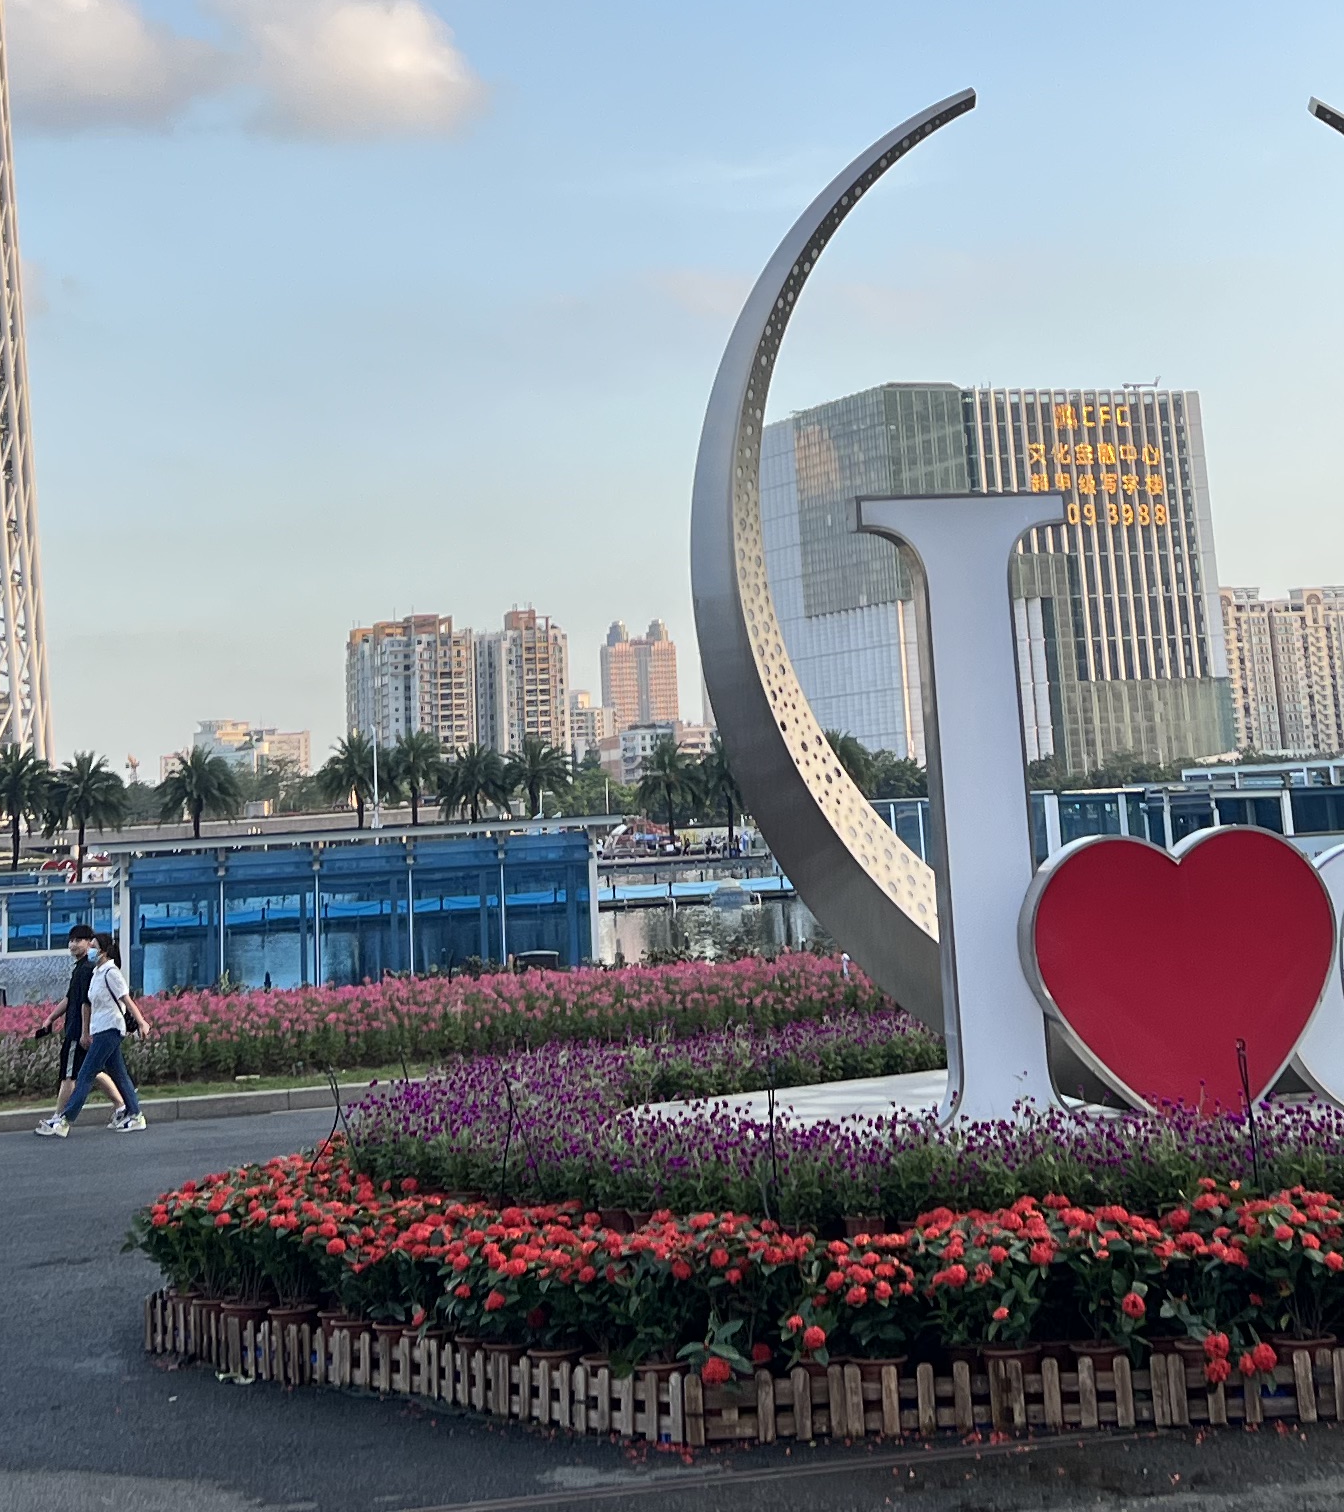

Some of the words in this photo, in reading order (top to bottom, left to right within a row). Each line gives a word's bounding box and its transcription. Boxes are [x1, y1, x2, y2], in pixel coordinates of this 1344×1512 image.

[1027, 441, 1161, 466] 文化金融中心
[856, 491, 1074, 1128] I
